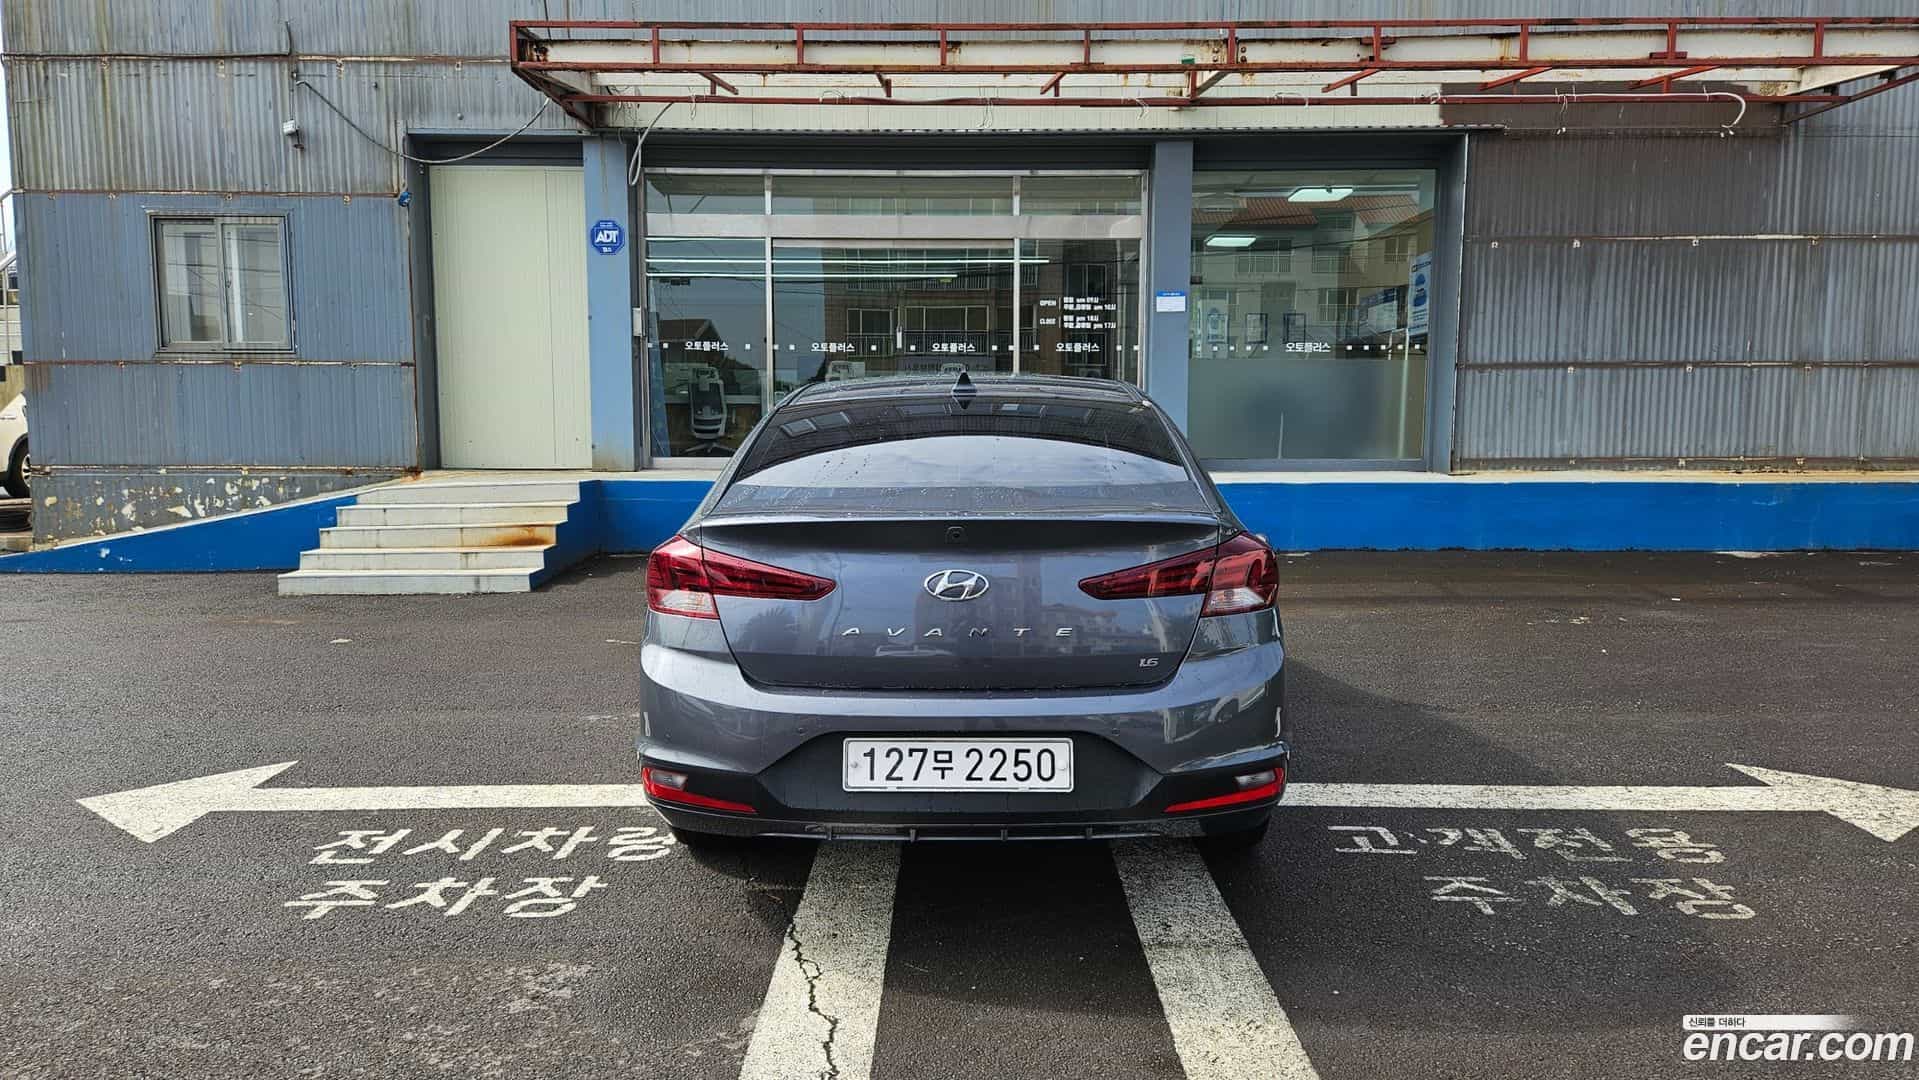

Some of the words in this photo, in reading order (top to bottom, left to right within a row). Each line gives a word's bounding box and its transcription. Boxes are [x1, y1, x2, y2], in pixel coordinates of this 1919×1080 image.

[595, 230, 619, 243] ADT
[684, 341, 729, 351] 오토플러스
[811, 342, 855, 352] 오토플러스
[931, 343, 975, 353] 오토플러스
[1055, 342, 1100, 352] 오토플러스
[1285, 342, 1331, 353] 오토플러스
[842, 627, 1074, 637] AVANTE
[863, 747, 954, 781] 127무
[965, 747, 1056, 782] 2250
[284, 875, 608, 920] 주차장
[1424, 875, 1756, 920] 주차장
